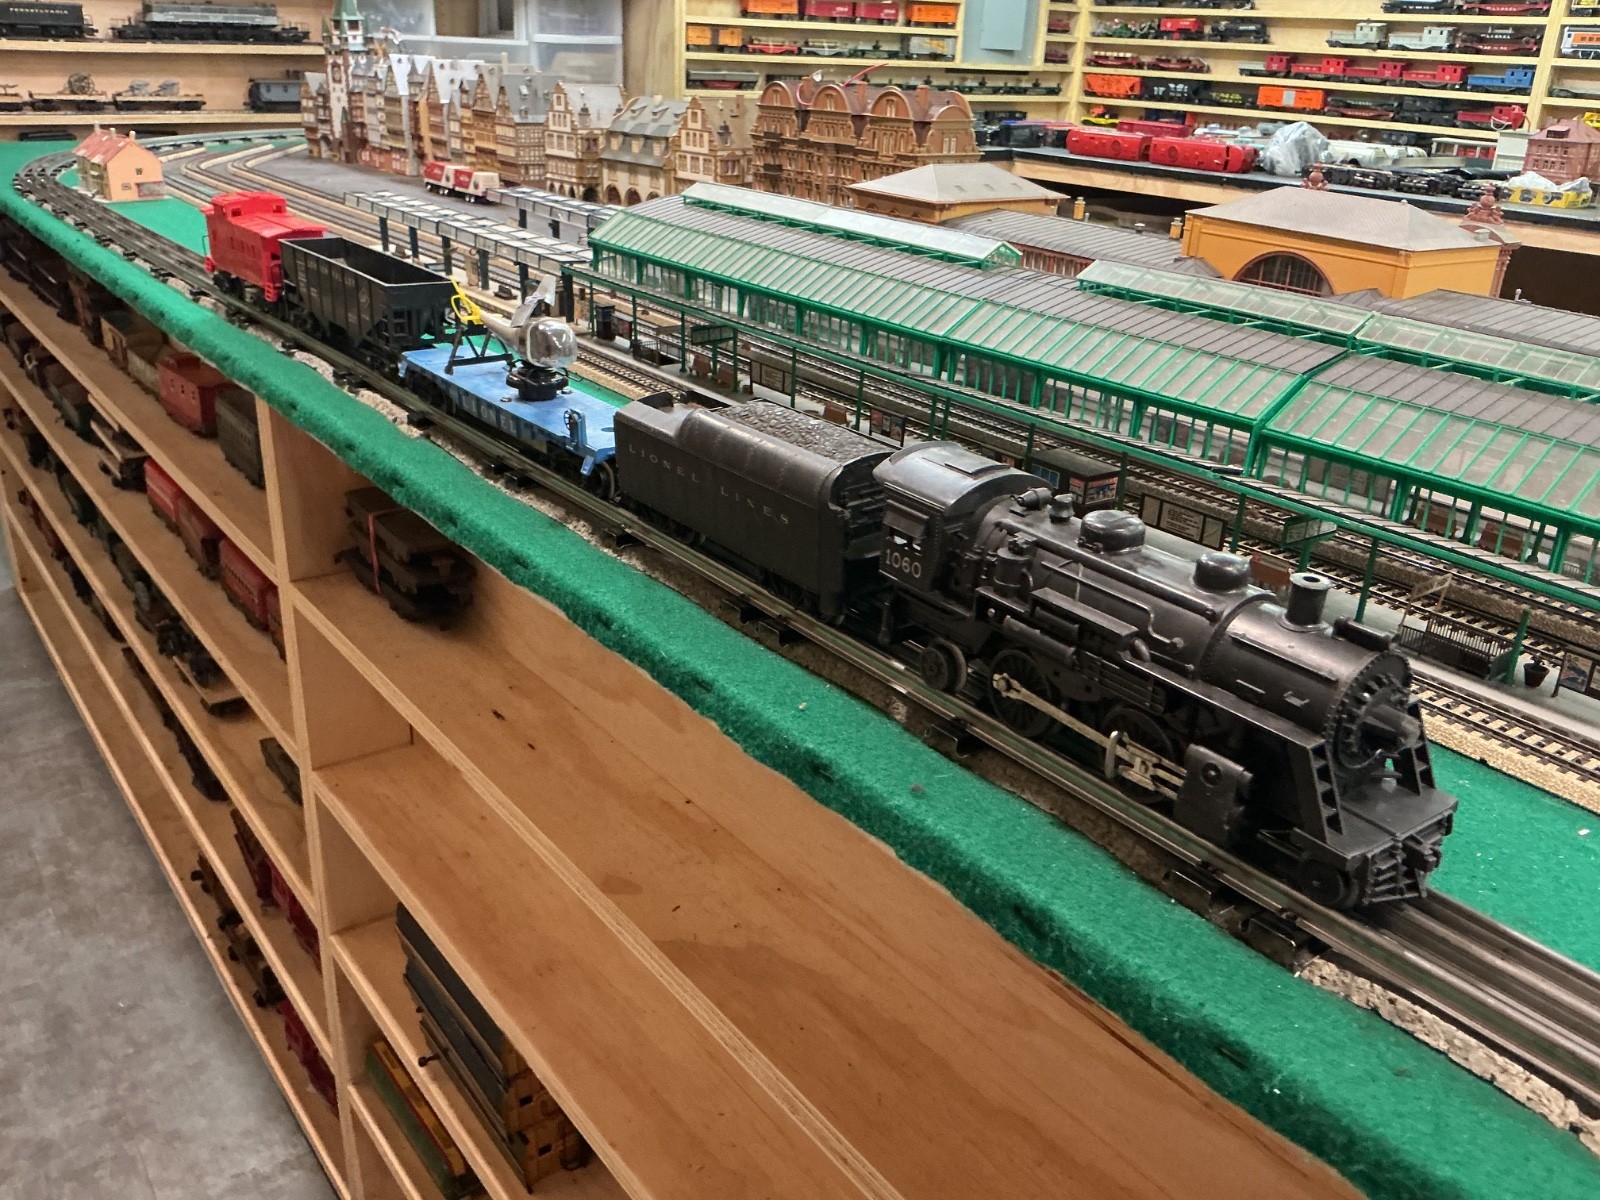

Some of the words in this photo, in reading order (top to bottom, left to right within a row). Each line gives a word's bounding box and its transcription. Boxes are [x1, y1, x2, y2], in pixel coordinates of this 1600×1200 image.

[461, 395, 518, 434] LIONEL
[628, 443, 702, 484] LIONEL
[719, 485, 790, 526] LINES
[884, 547, 923, 580] 1060
